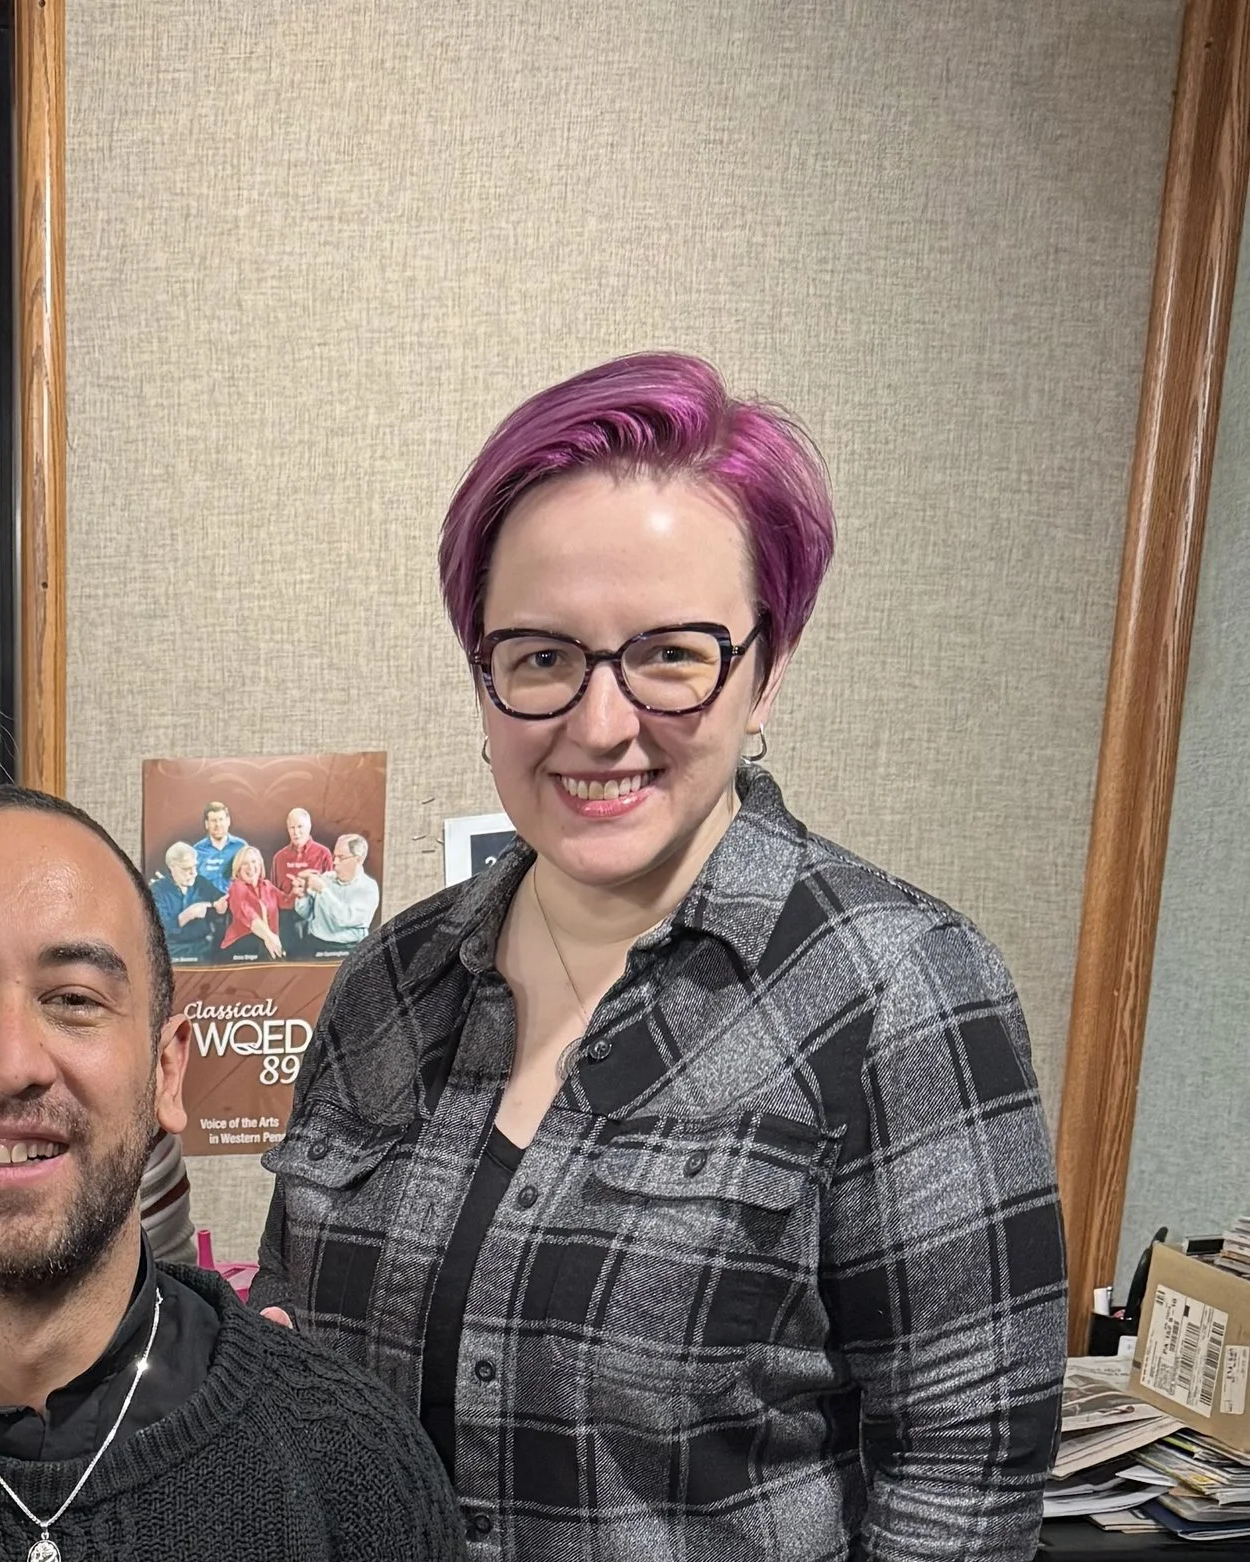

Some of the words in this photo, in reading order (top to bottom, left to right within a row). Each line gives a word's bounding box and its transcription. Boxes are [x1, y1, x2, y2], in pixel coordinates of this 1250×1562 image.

[183, 998, 278, 1020] Classical
[193, 1018, 313, 1058] WQED
[259, 1055, 301, 1085] 89
[200, 1118, 227, 1130] Voice
[229, 1117, 240, 1129] of
[241, 1117, 258, 1128] the
[258, 1116, 280, 1128] Arts
[209, 1133, 219, 1144] in
[221, 1132, 261, 1144] Western
